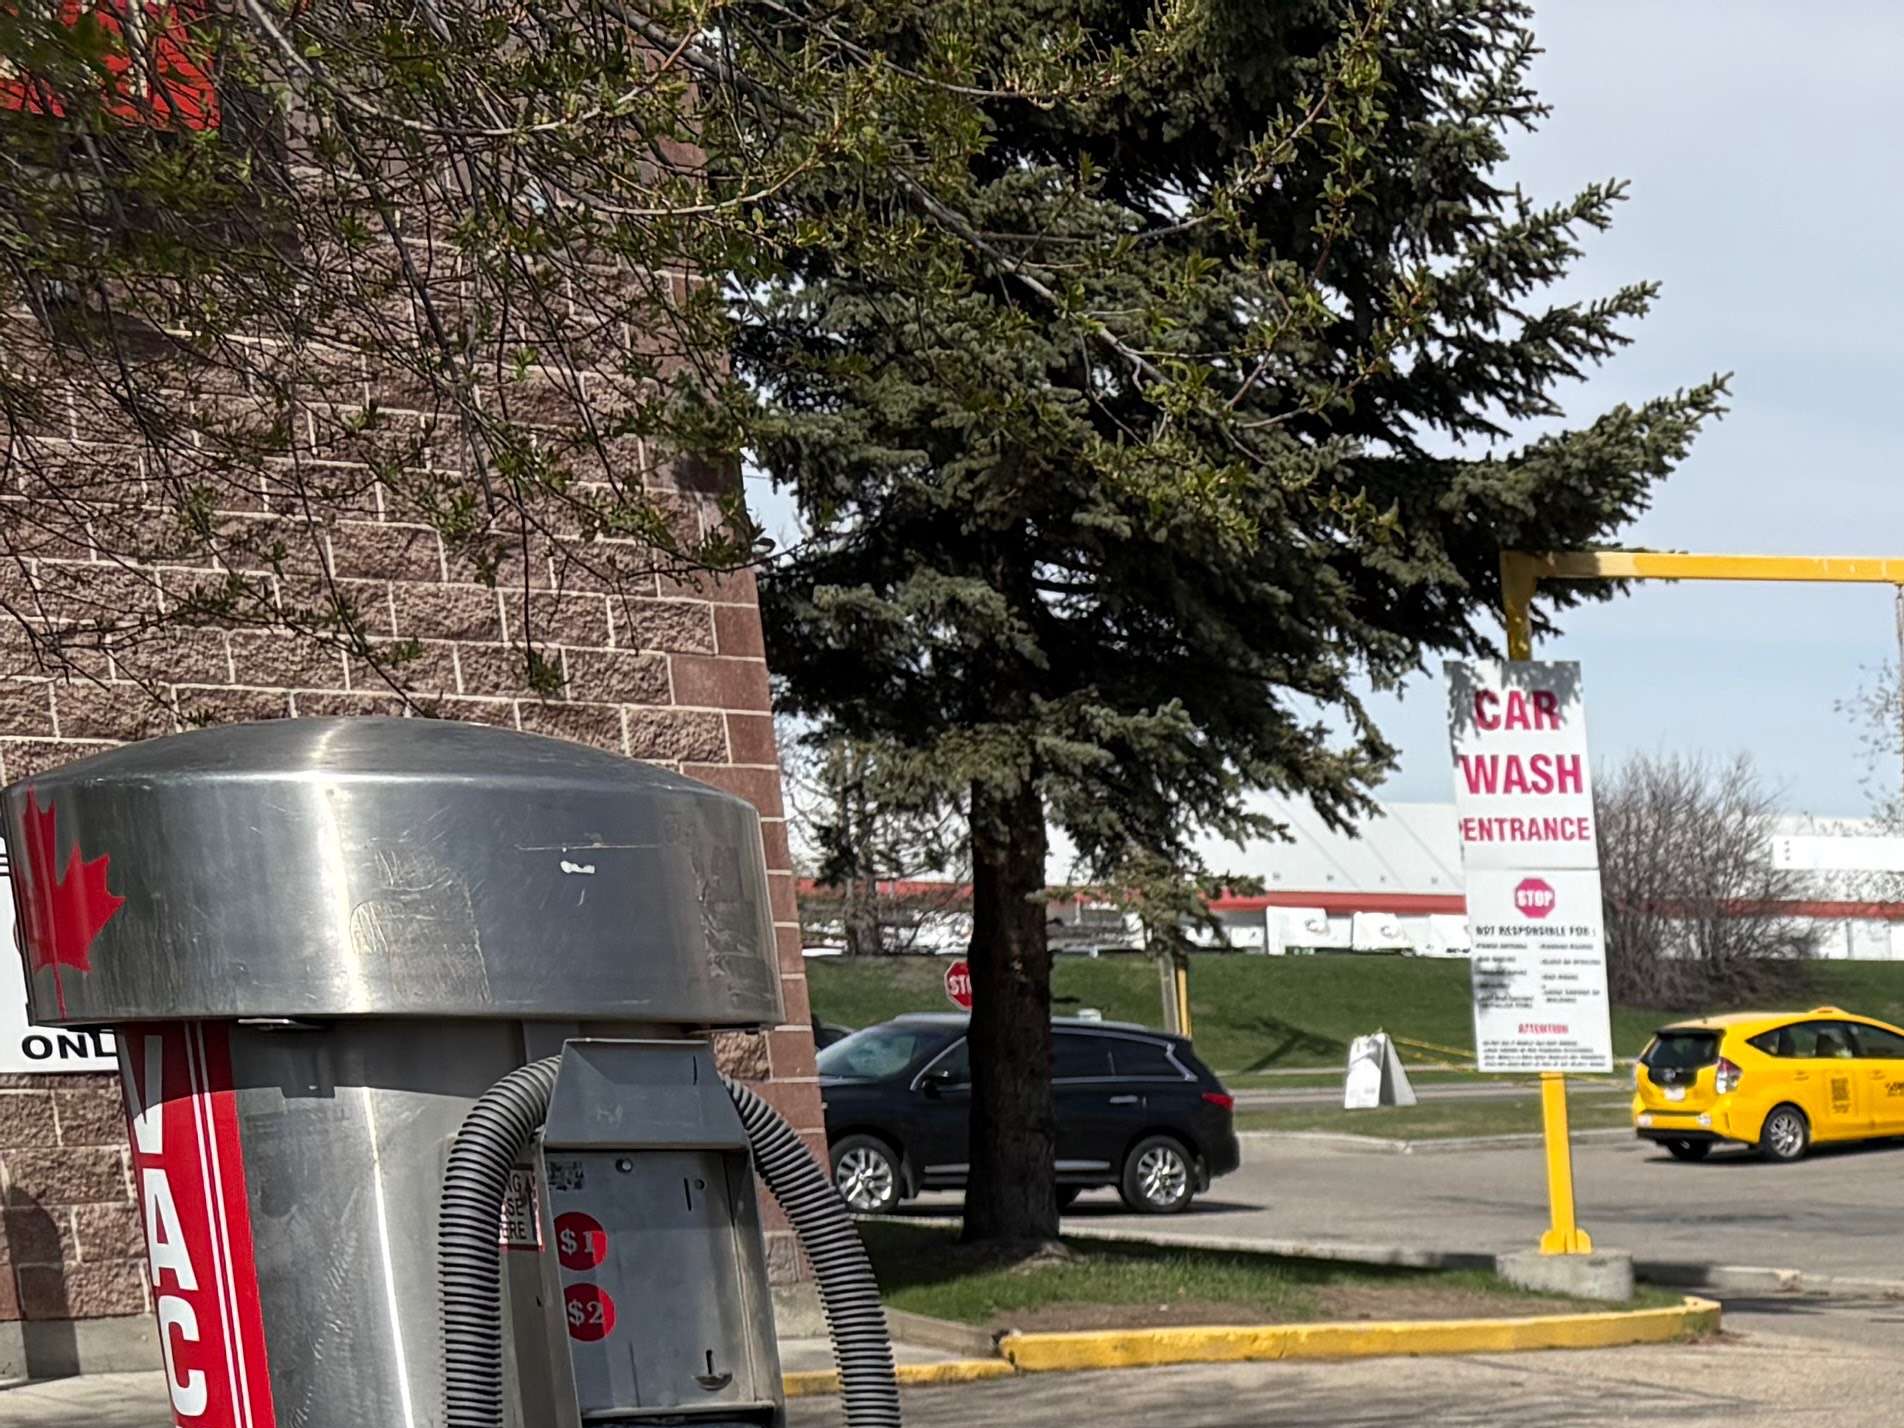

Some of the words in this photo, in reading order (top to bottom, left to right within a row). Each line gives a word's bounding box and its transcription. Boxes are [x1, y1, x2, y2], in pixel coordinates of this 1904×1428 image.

[1475, 690, 1560, 731] CAR
[1460, 753, 1584, 795] WASH
[1464, 816, 1591, 842] ENTRANCE
[1516, 890, 1553, 908] STOP
[21, 1031, 118, 1060] ONL
[559, 1228, 594, 1255] $1
[567, 1299, 605, 1327] $2
